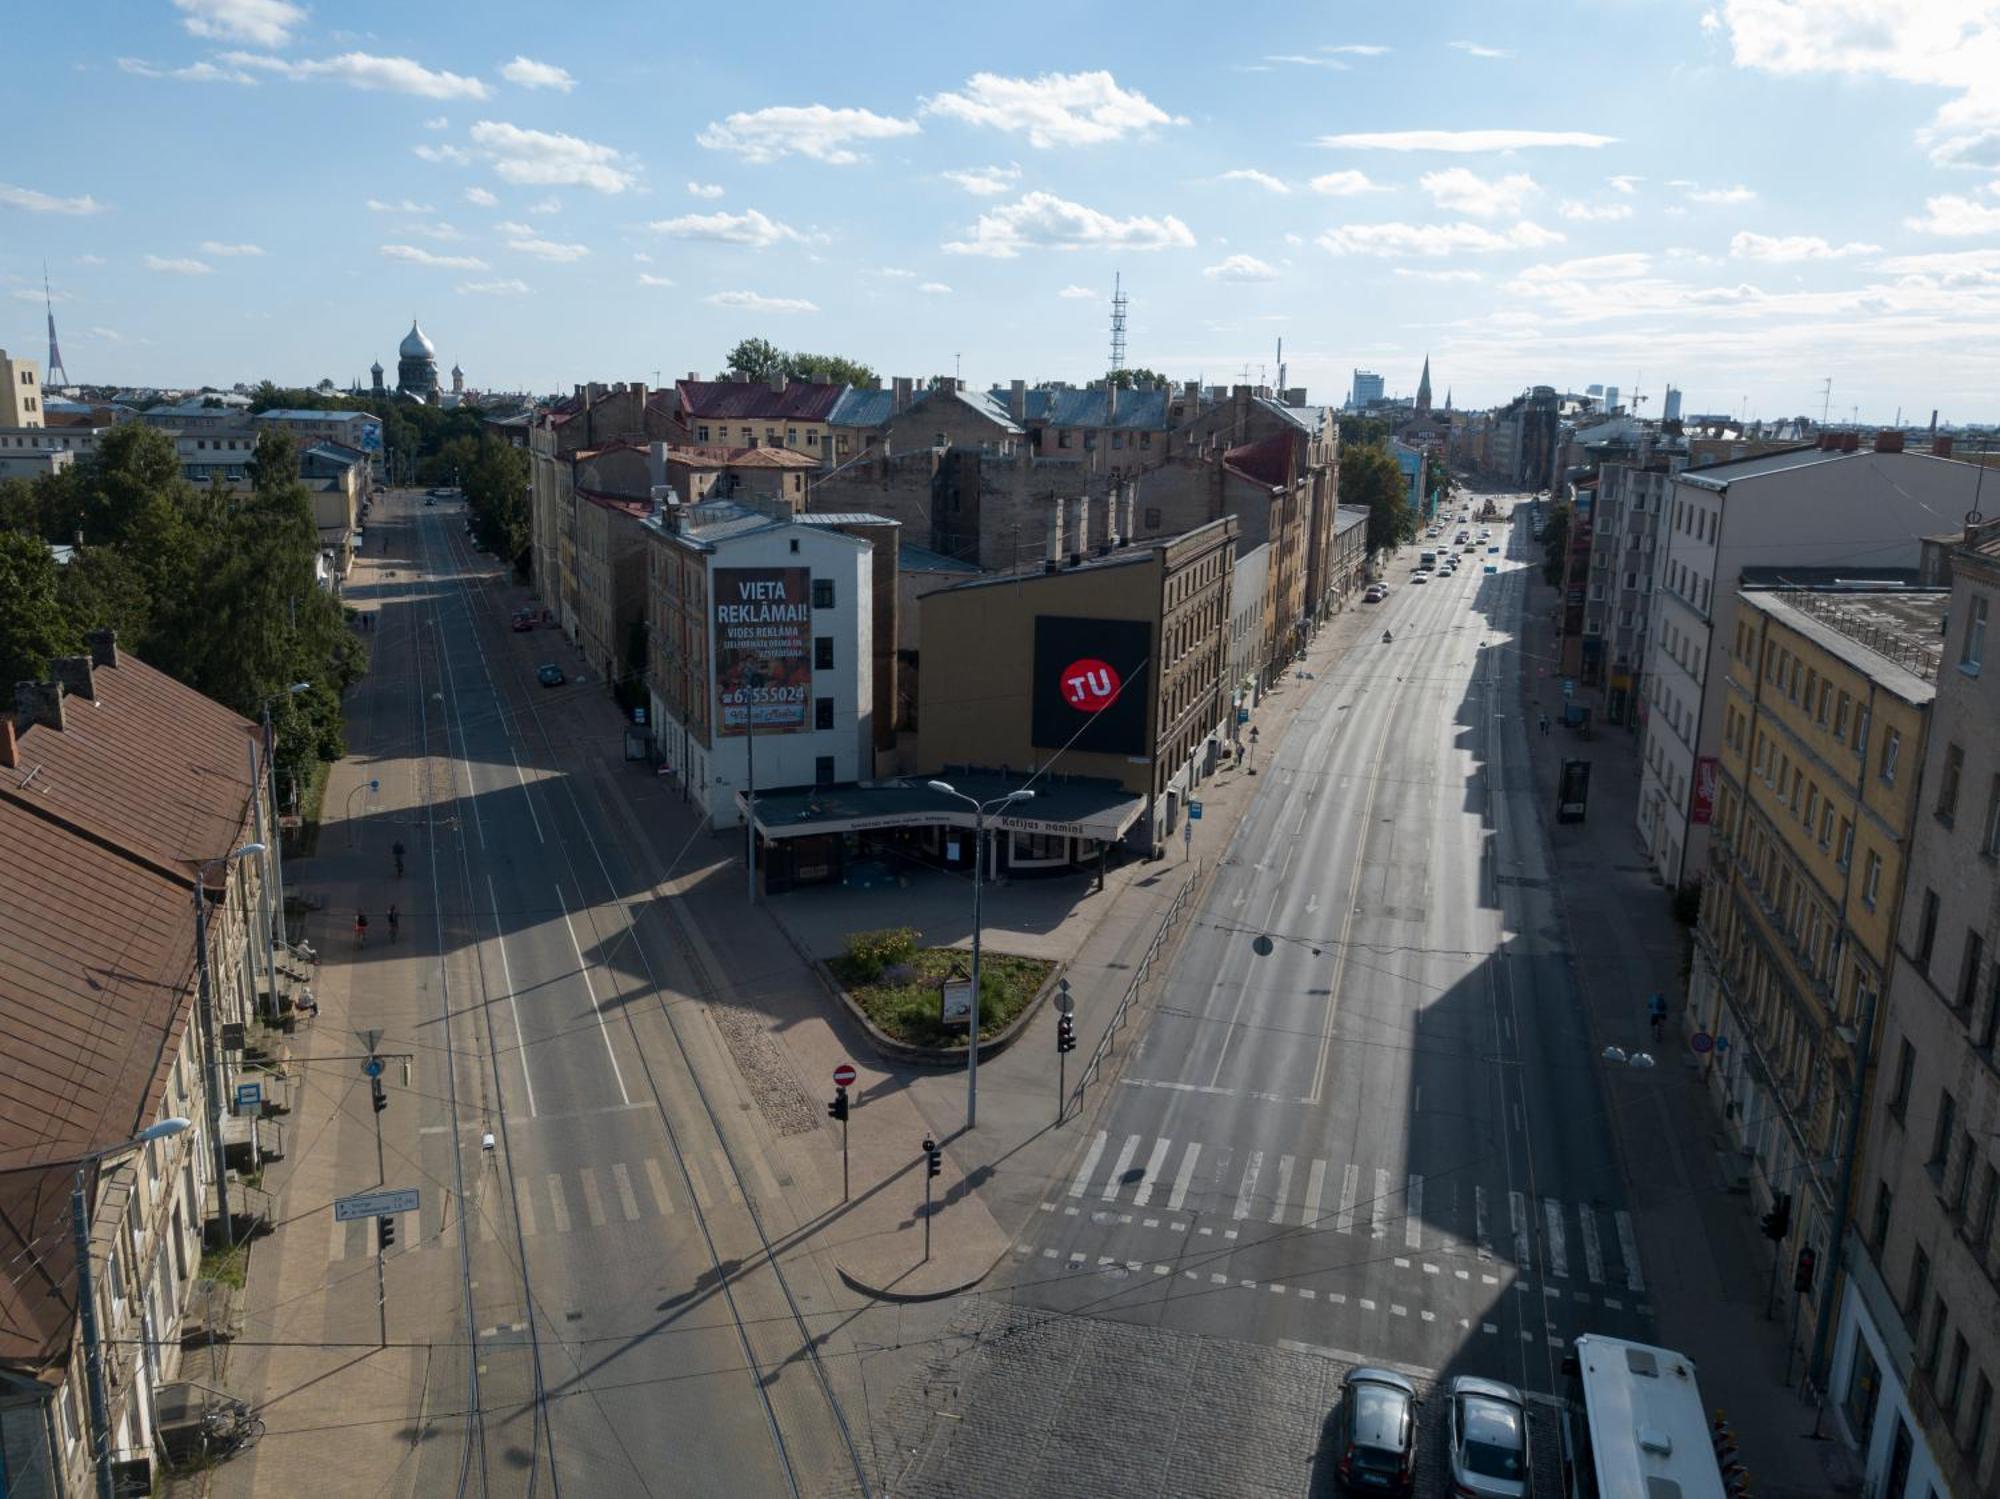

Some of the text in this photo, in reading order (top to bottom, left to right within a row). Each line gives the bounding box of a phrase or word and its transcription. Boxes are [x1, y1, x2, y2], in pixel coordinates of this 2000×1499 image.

[738, 581, 786, 600] VIETA
[718, 601, 808, 624] REKLĀMAI!
[727, 626, 754, 639] VIDES
